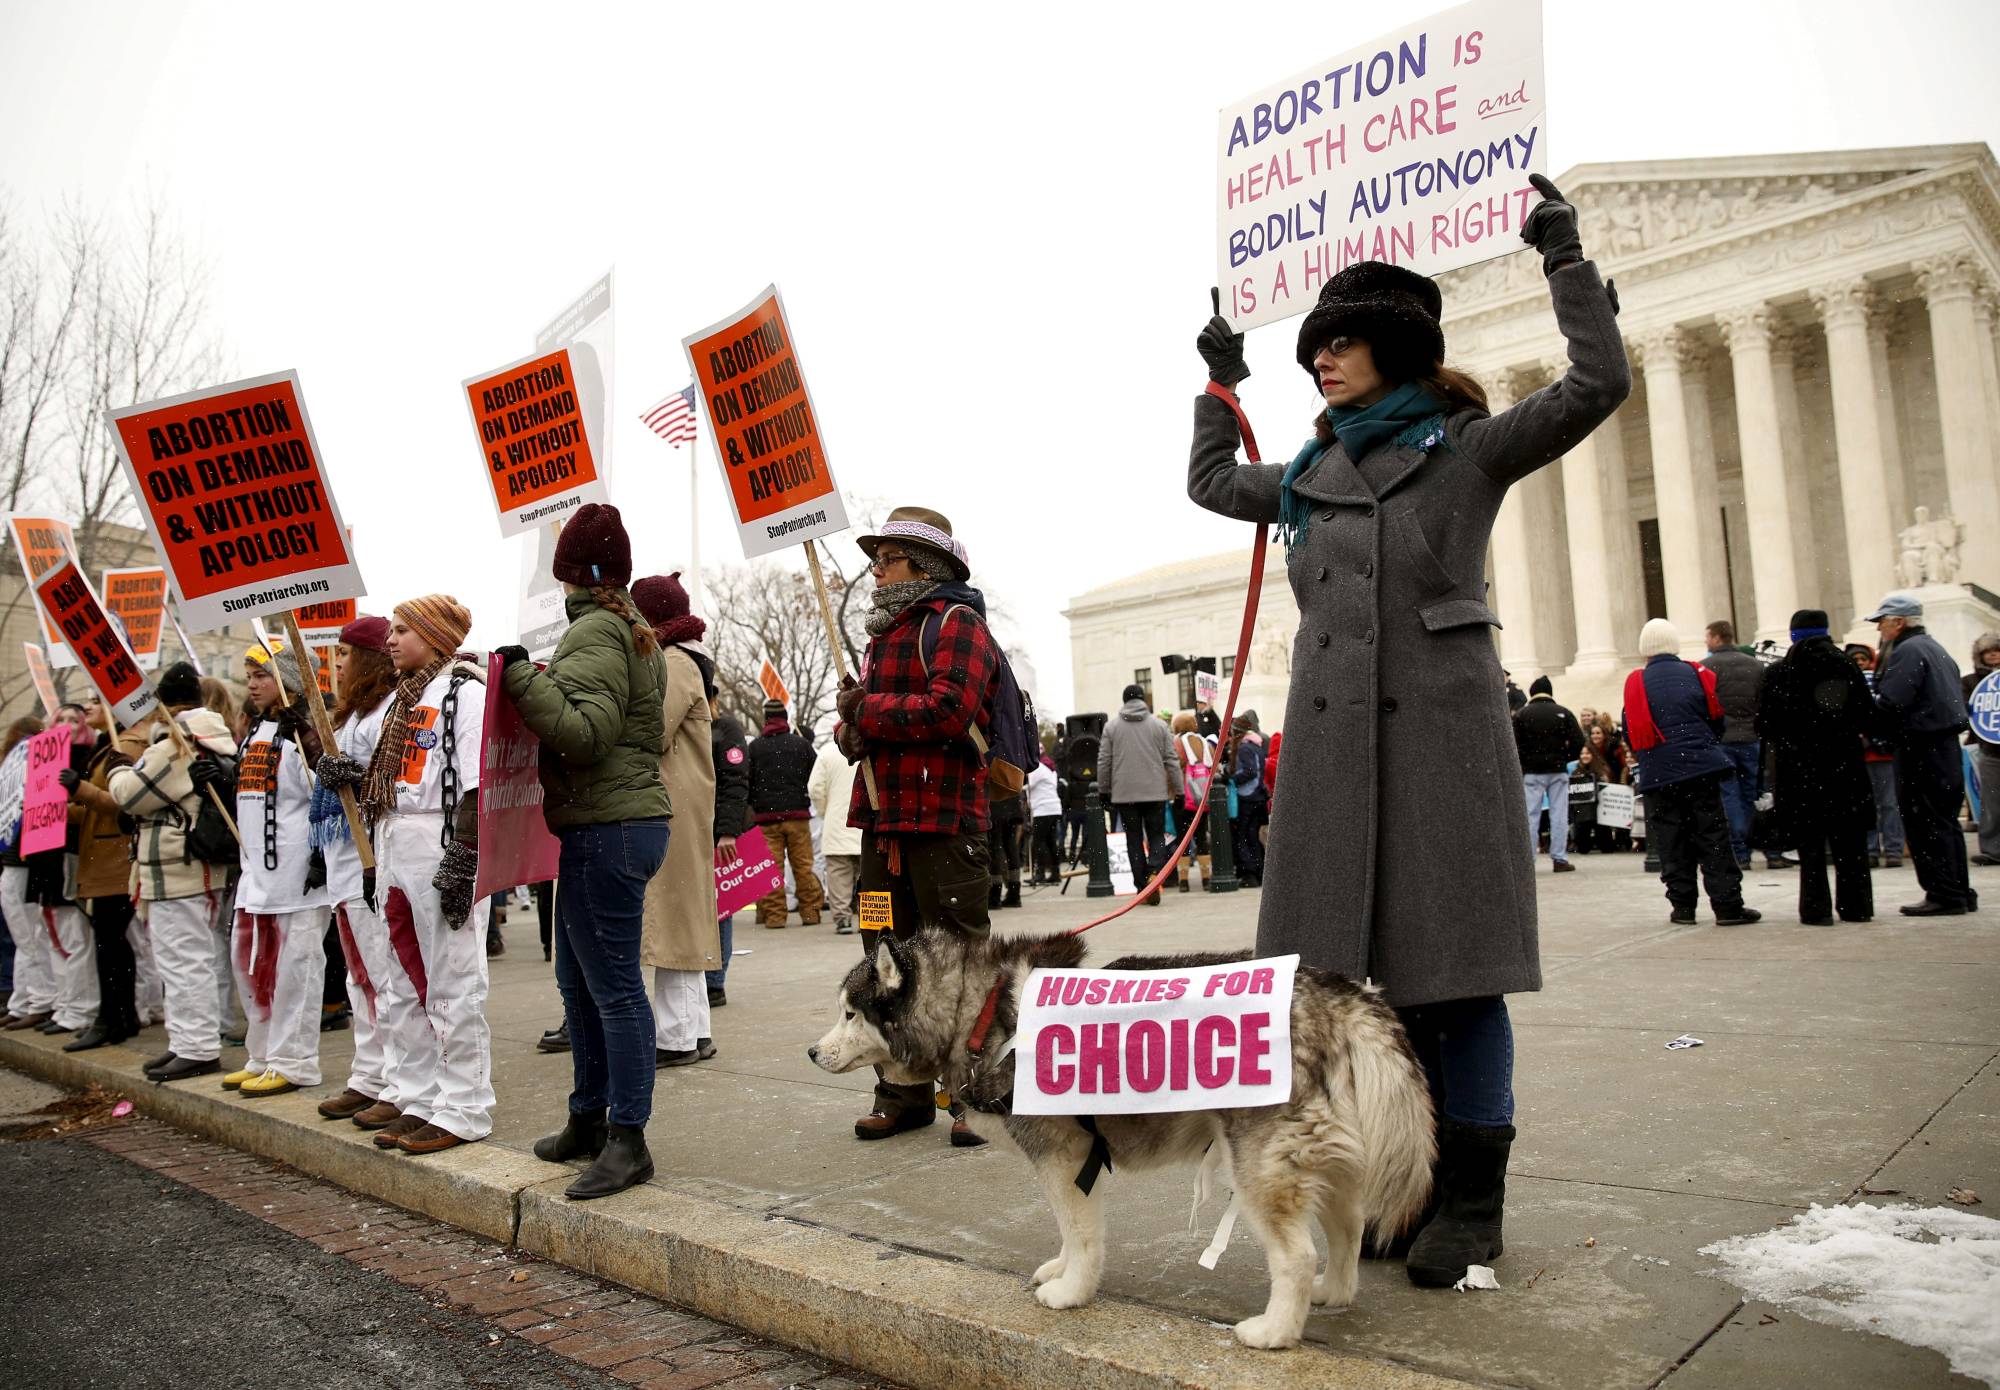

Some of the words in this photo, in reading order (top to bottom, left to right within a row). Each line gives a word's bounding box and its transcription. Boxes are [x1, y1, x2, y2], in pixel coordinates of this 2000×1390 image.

[1227, 32, 1427, 157] ABORTION
[1453, 30, 1484, 68] IS
[1227, 123, 1347, 210] HEALTH
[1363, 84, 1457, 154] CARE
[1477, 79, 1531, 119] and
[1229, 190, 1327, 269] BODILY
[1349, 126, 1538, 224] AUTONOMY
[1232, 276, 1257, 319] IS
[1271, 260, 1291, 305] A
[1304, 221, 1415, 292] HUMAN
[1431, 185, 1540, 255] RIGHT
[709, 315, 785, 385] ABORTION
[482, 362, 565, 414] ABORTION
[712, 387, 743, 427] ON
[741, 357, 800, 416] DEMAND
[147, 399, 292, 461] ABORTION
[482, 414, 507, 444] ON
[506, 390, 576, 434] DEMAND
[725, 437, 745, 467] &
[742, 400, 812, 460] WITHOUT
[490, 450, 506, 473] &
[505, 419, 581, 466] WITHOUT
[147, 469, 195, 504] ON
[195, 439, 310, 492] DEMAND
[507, 451, 577, 497] APOLOGY
[748, 446, 817, 502] APOLOGY
[165, 514, 193, 544] &
[194, 480, 322, 536] WITHOUT
[519, 495, 581, 524] StopPatriarchy.org
[766, 509, 827, 539] StopPatriarchy.org
[199, 521, 321, 577] APOLOGY
[112, 577, 162, 595] ABORTION
[123, 595, 162, 611] DEMAND
[222, 578, 330, 614] StopPatriarchy.org
[62, 610, 91, 641] ON
[300, 601, 348, 621] APOLOGY
[82, 646, 101, 667] &
[33, 731, 71, 769] BODY
[491, 779, 513, 810] birth
[714, 858, 744, 878] Take
[720, 874, 743, 892] Our
[744, 858, 775, 878] Care.
[862, 894, 889, 903] ABORTION
[862, 915, 891, 923] APOLOGY!
[1036, 976, 1190, 1007] HUSKIES
[1204, 967, 1275, 997] FOR
[1035, 1012, 1271, 1096] CHOICE
